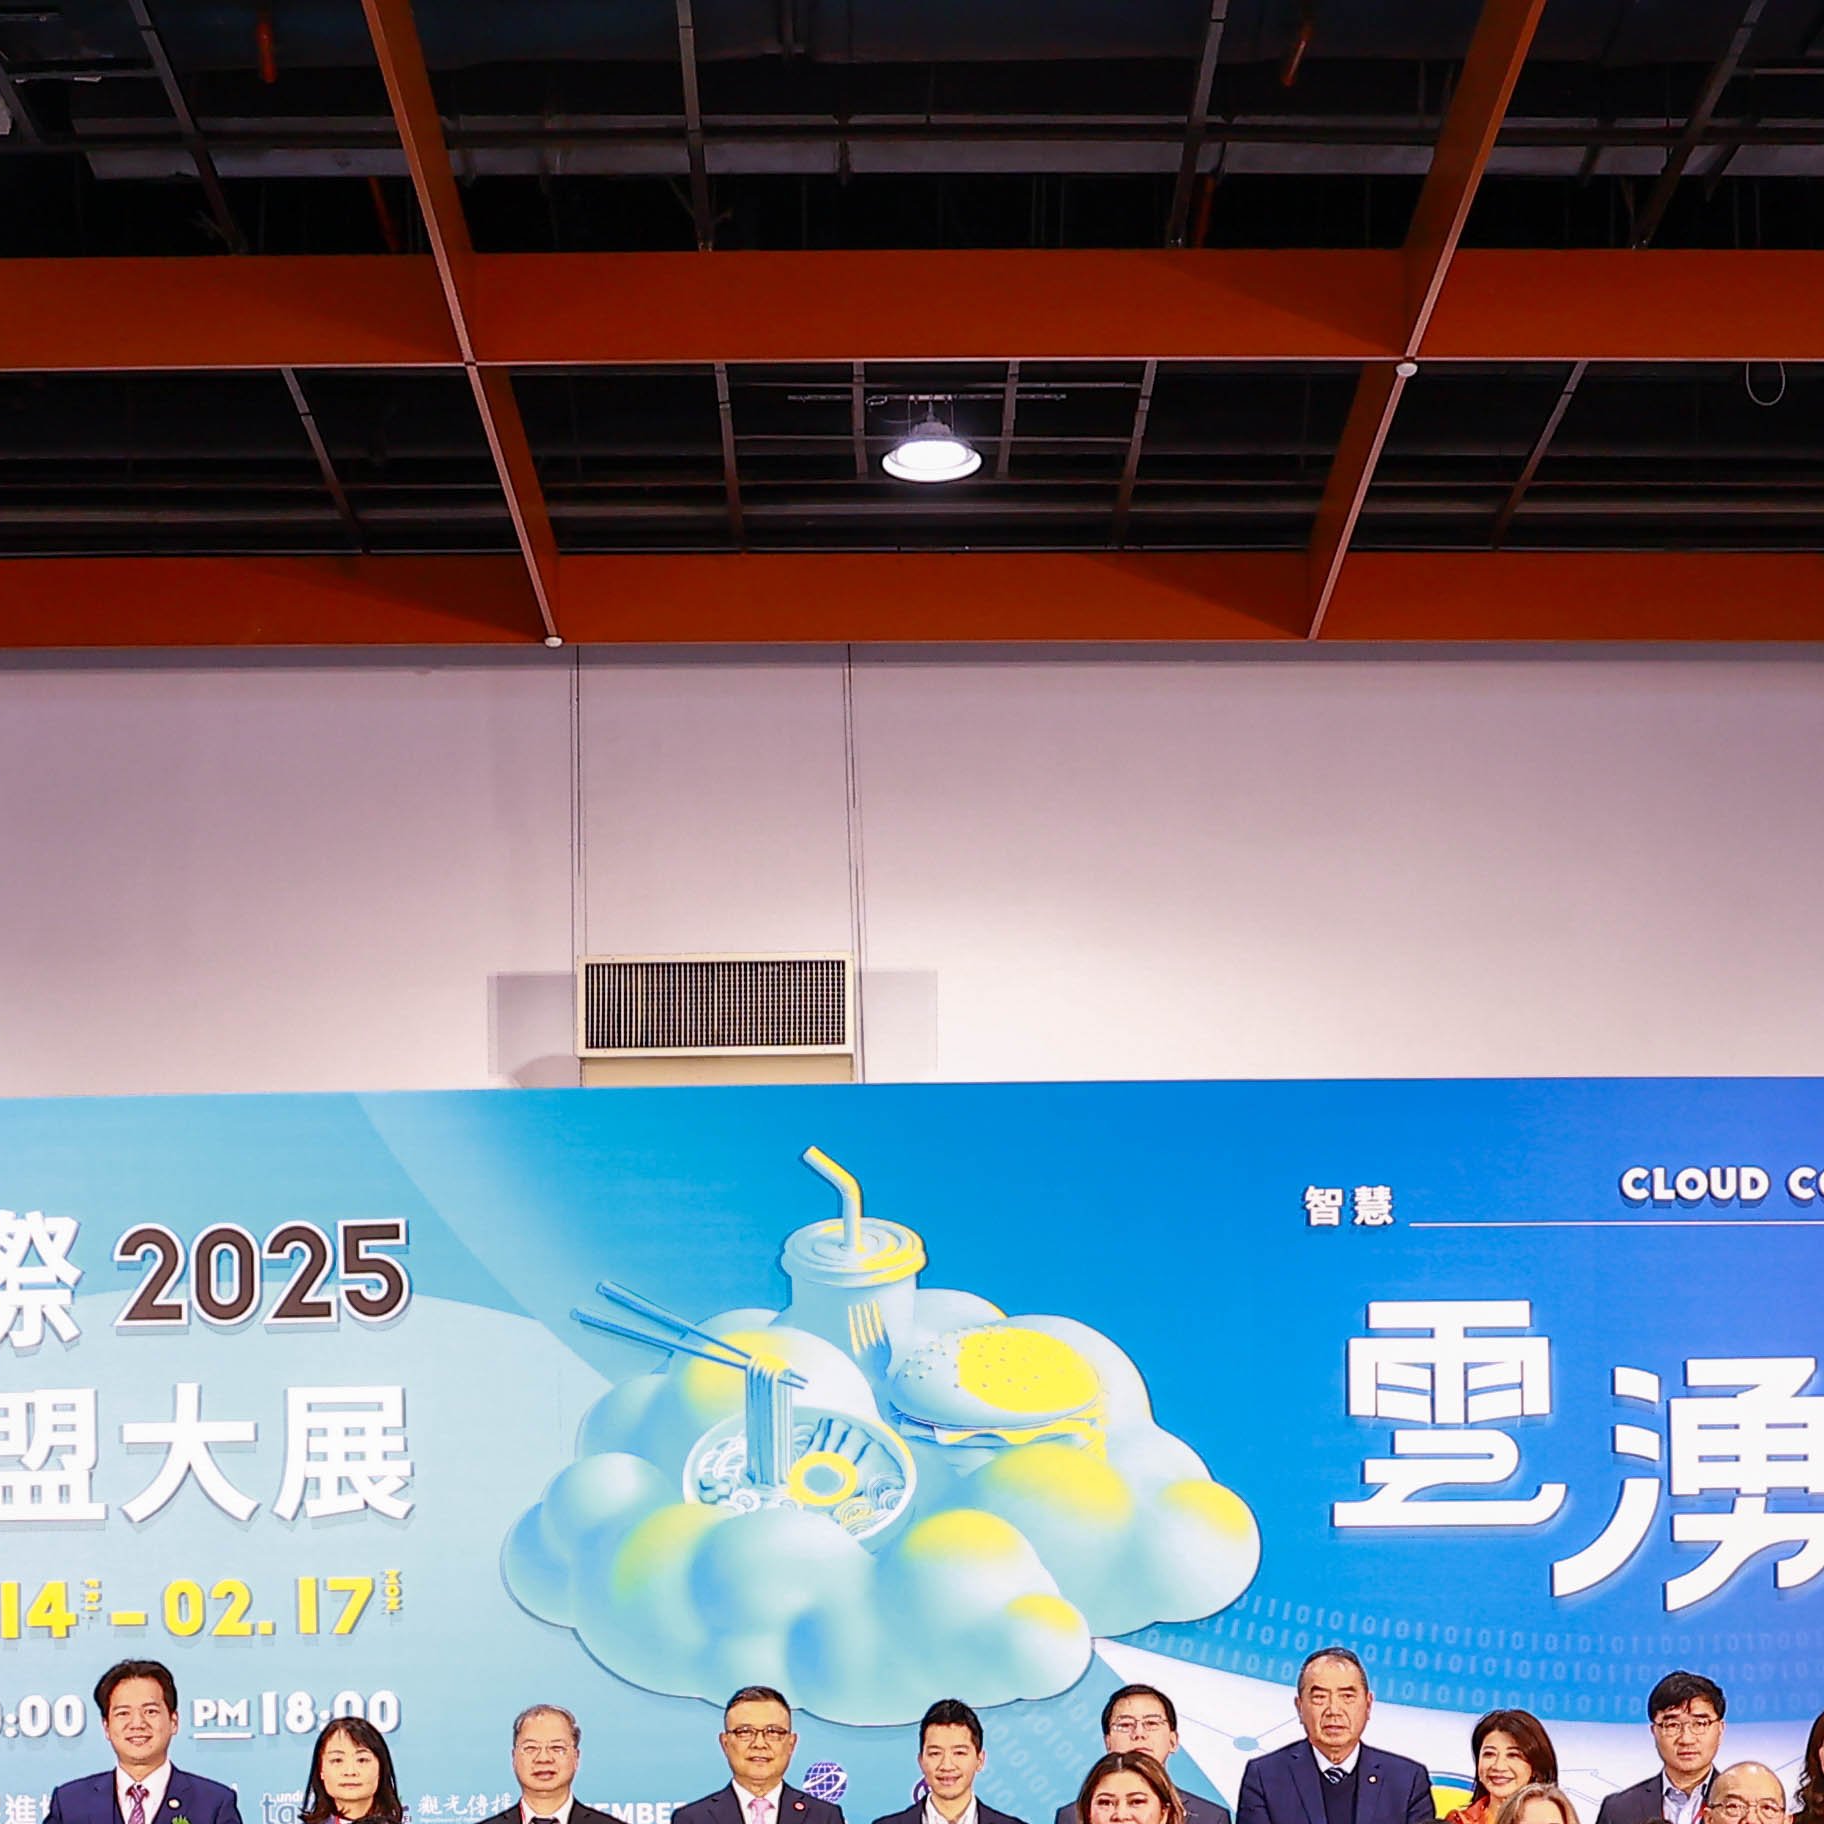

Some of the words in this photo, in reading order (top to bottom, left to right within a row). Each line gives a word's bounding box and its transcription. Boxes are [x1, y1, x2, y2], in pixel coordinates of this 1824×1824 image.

[1620, 1166, 1770, 1204] CLOUD
[1303, 1185, 1395, 1228] 智慧
[112, 1217, 412, 1329] 2025
[193, 1698, 252, 1728] PM
